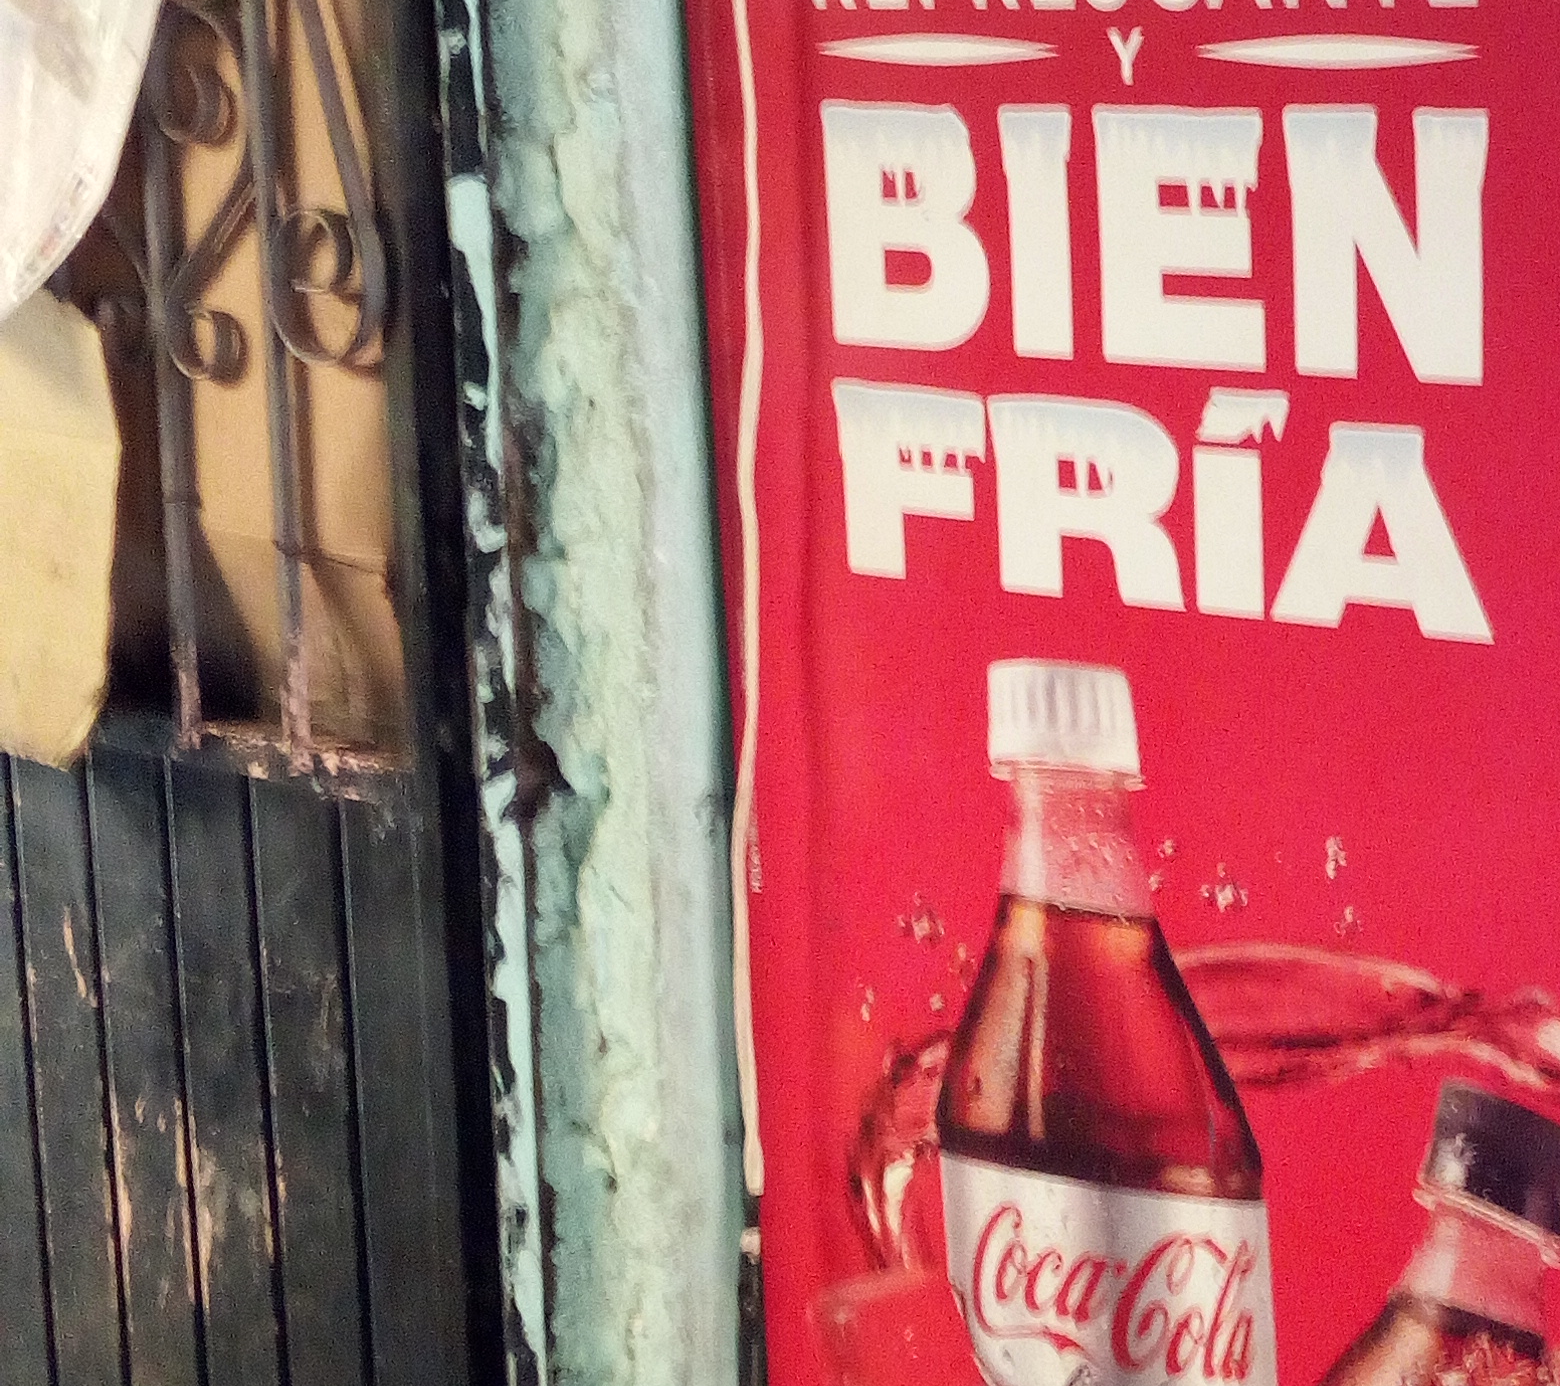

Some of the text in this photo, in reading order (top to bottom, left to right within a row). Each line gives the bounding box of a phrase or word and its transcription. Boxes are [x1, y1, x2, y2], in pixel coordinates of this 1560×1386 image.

[1106, 26, 1144, 86] Y
[819, 99, 1490, 386] BIEN
[830, 376, 1495, 645] FRÍA
[973, 1204, 1255, 1384] Coca-Cola
